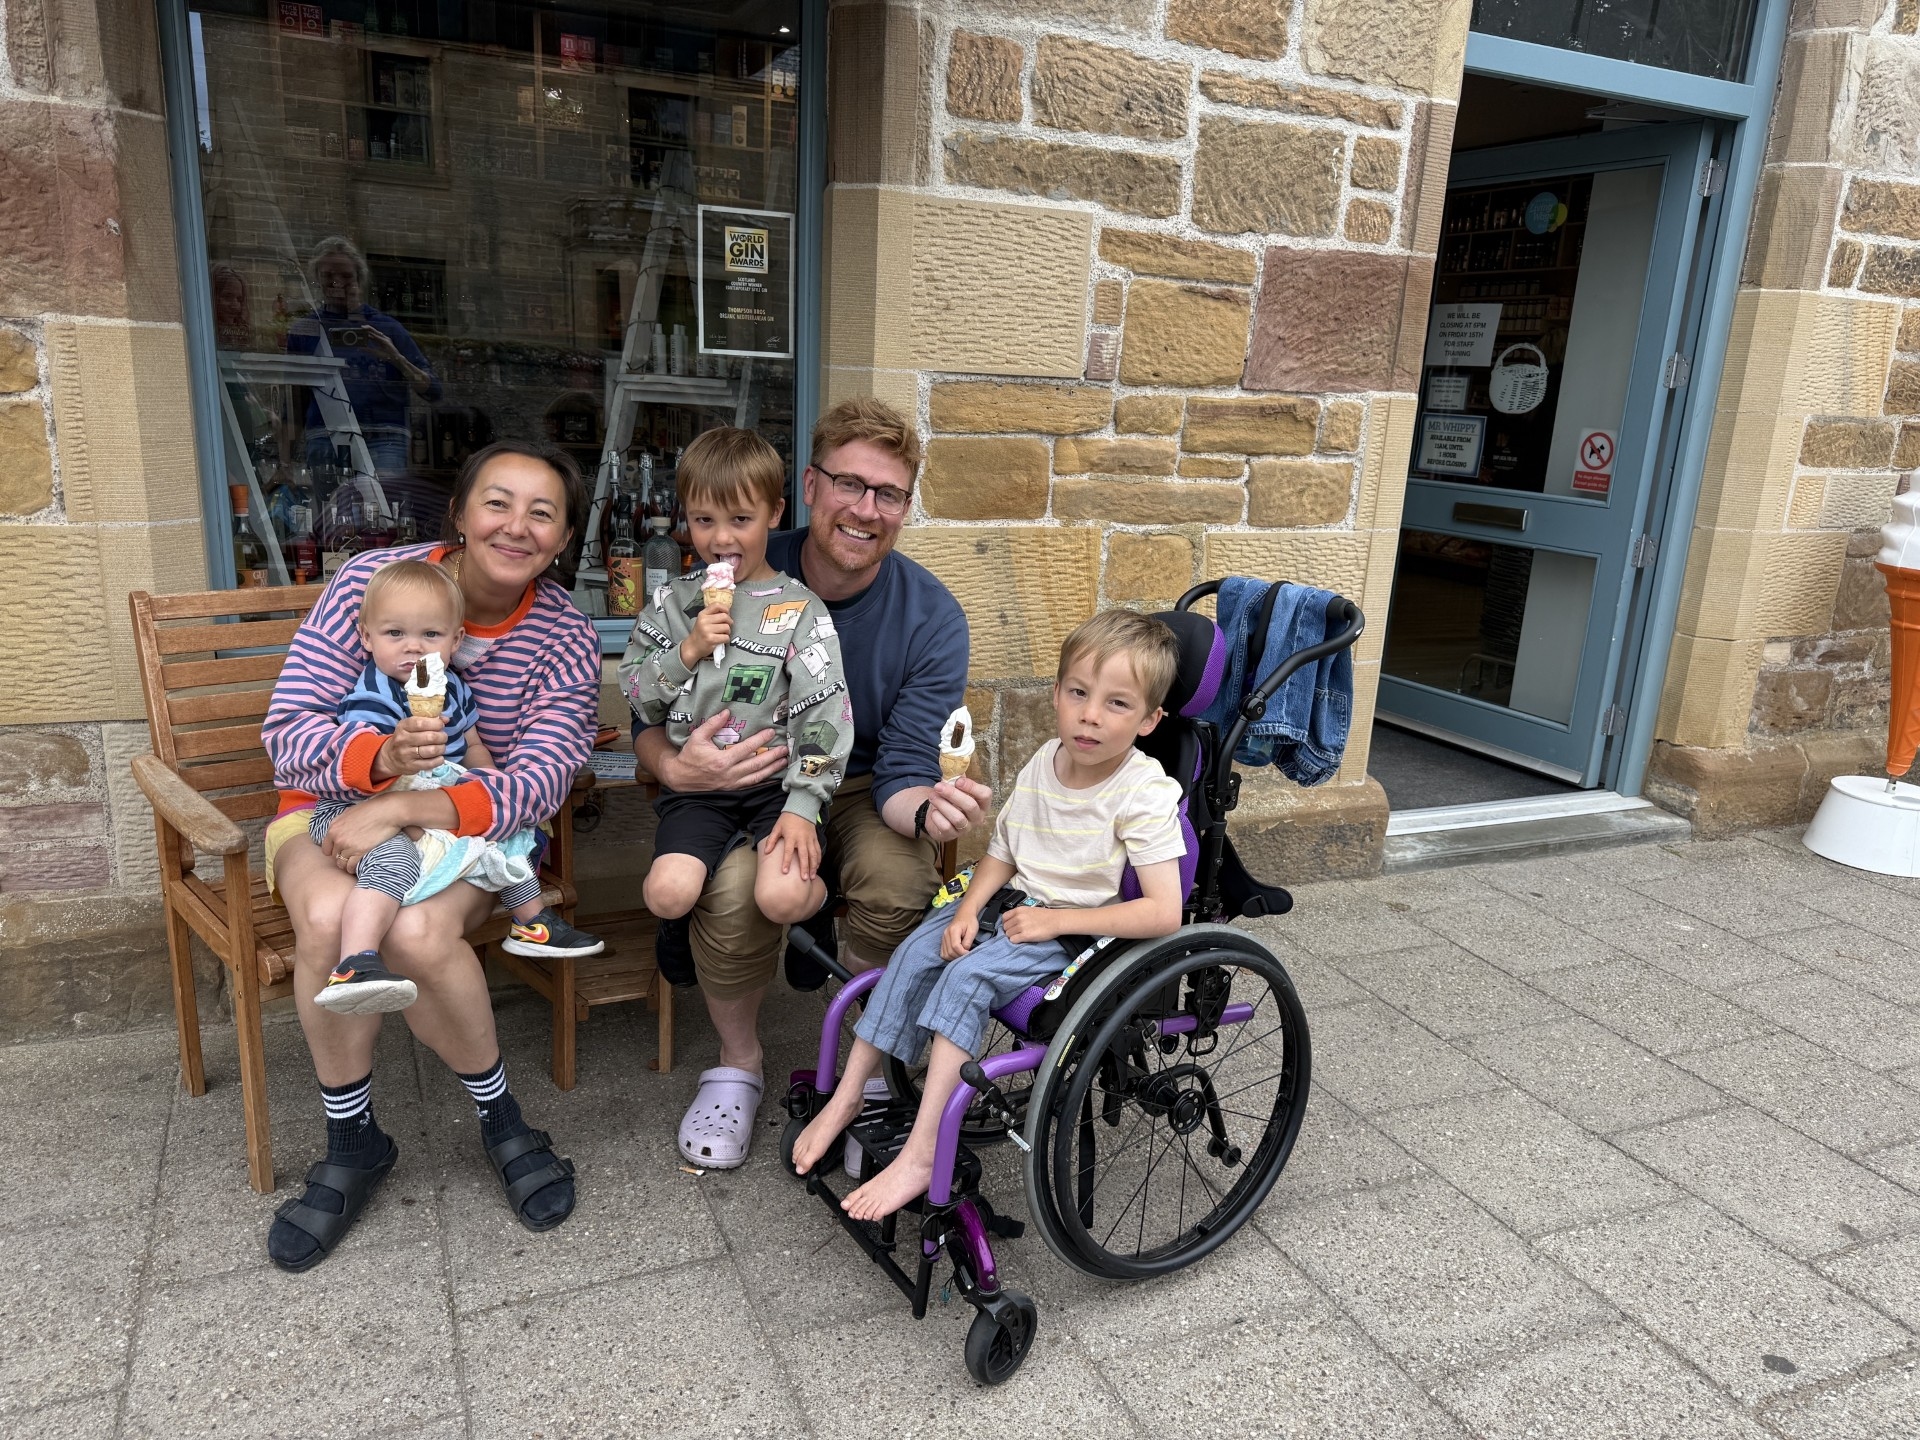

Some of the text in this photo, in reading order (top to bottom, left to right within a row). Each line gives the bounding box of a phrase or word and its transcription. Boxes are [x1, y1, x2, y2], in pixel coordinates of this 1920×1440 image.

[730, 233, 764, 243] WORLD
[730, 242, 764, 259] GIN
[730, 258, 764, 267] AWARDS
[1428, 421, 1477, 433] MR WHIPPY
[789, 681, 845, 717] MINECRAFT
